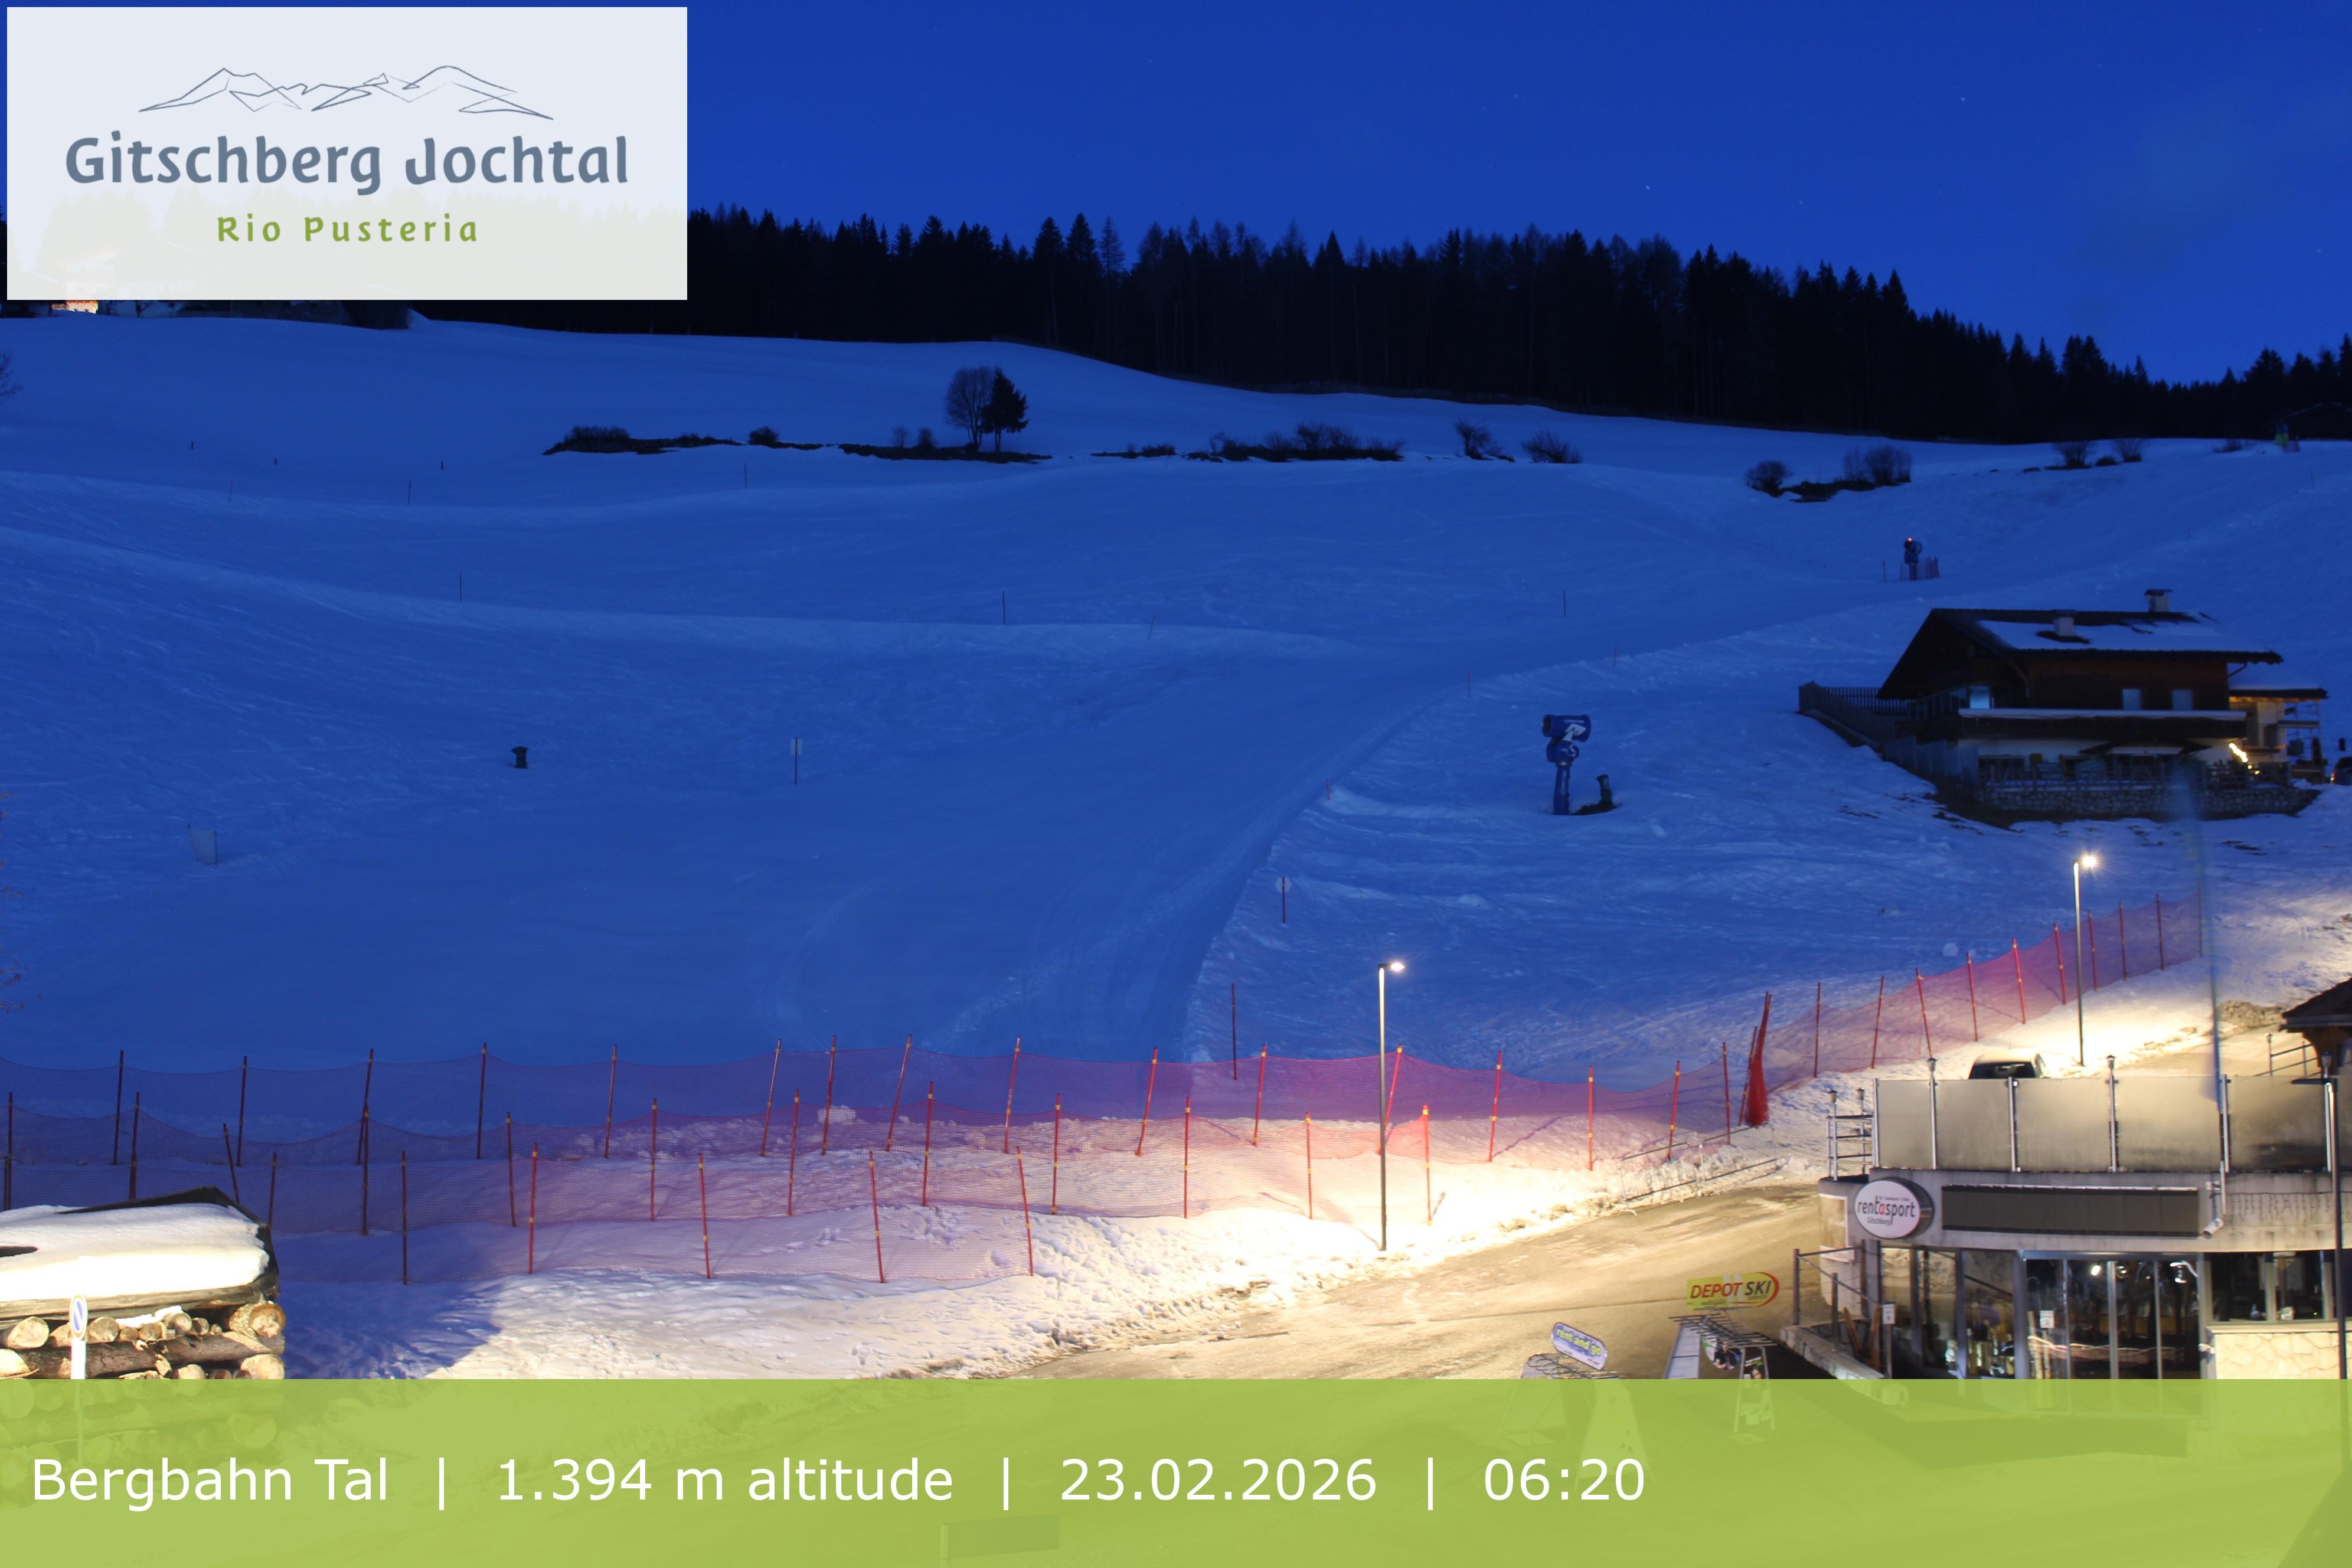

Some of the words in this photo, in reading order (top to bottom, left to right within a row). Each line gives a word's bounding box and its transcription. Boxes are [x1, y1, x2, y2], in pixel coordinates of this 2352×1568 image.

[1857, 1195, 1916, 1226] rentasport
[1690, 1282, 1743, 1299] DEPOT
[1744, 1280, 1772, 1296] SKI
[1556, 1329, 1573, 1342] rent
[1573, 1337, 1590, 1350] and
[1590, 1345, 1602, 1356] go
